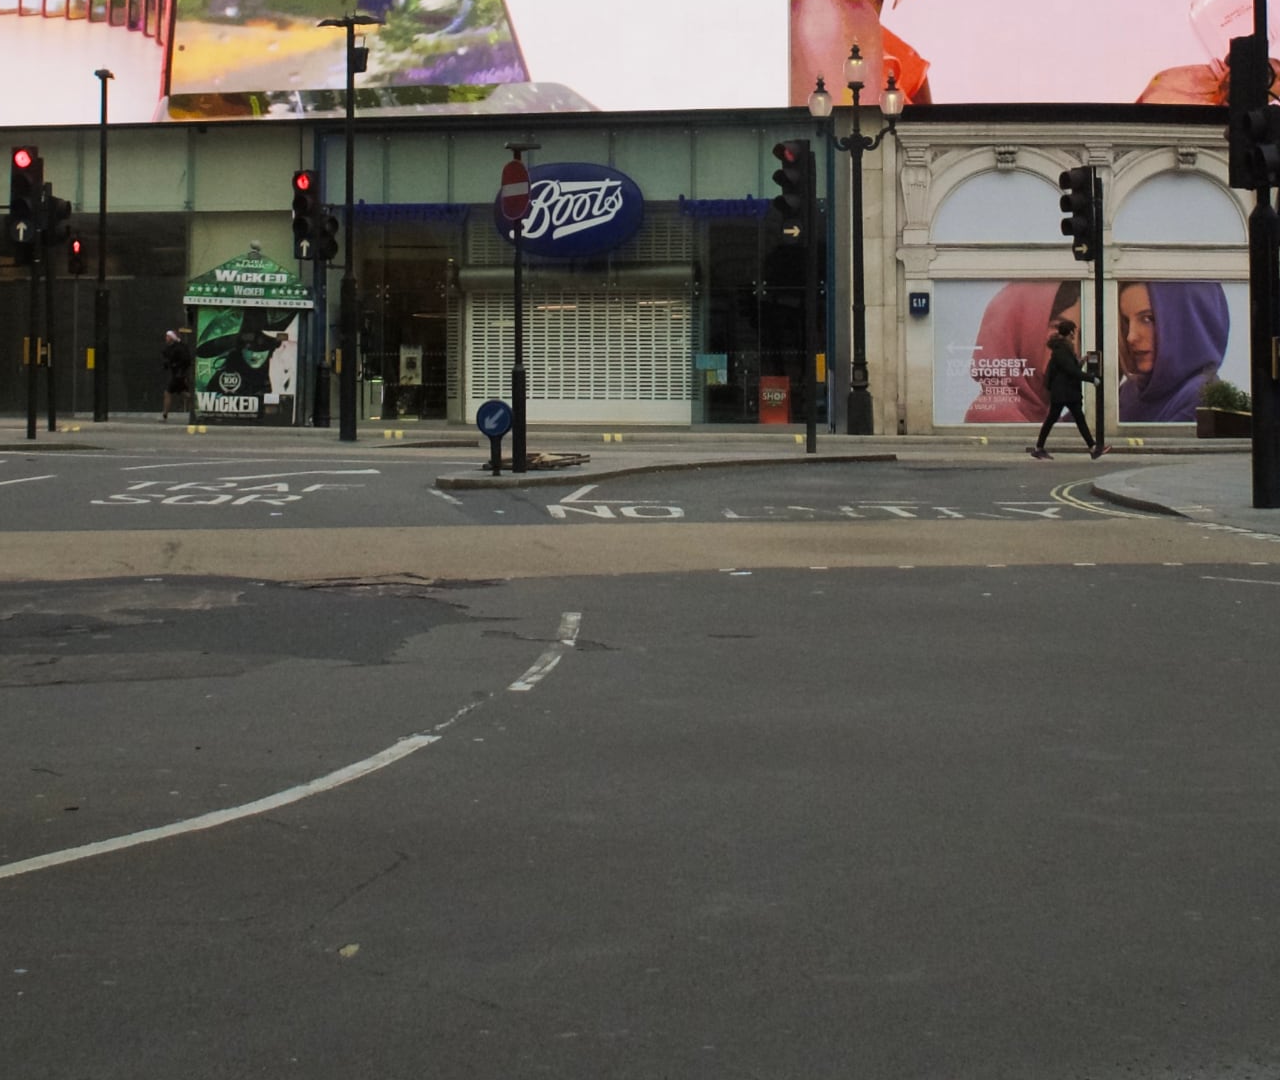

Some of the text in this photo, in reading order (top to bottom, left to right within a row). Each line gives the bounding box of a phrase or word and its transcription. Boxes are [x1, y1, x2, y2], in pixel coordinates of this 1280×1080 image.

[509, 178, 623, 241] Boots
[978, 358, 1028, 368] CLOSEST
[971, 367, 1008, 377] STORE
[1009, 367, 1020, 377] IS
[1022, 367, 1036, 377] AT
[222, 376, 238, 385] 100
[974, 377, 1012, 386] AGSHIP
[762, 391, 787, 401] SHOP
[126, 480, 366, 492] TRAF
[90, 494, 304, 505] SQR
[546, 504, 685, 519] NO
